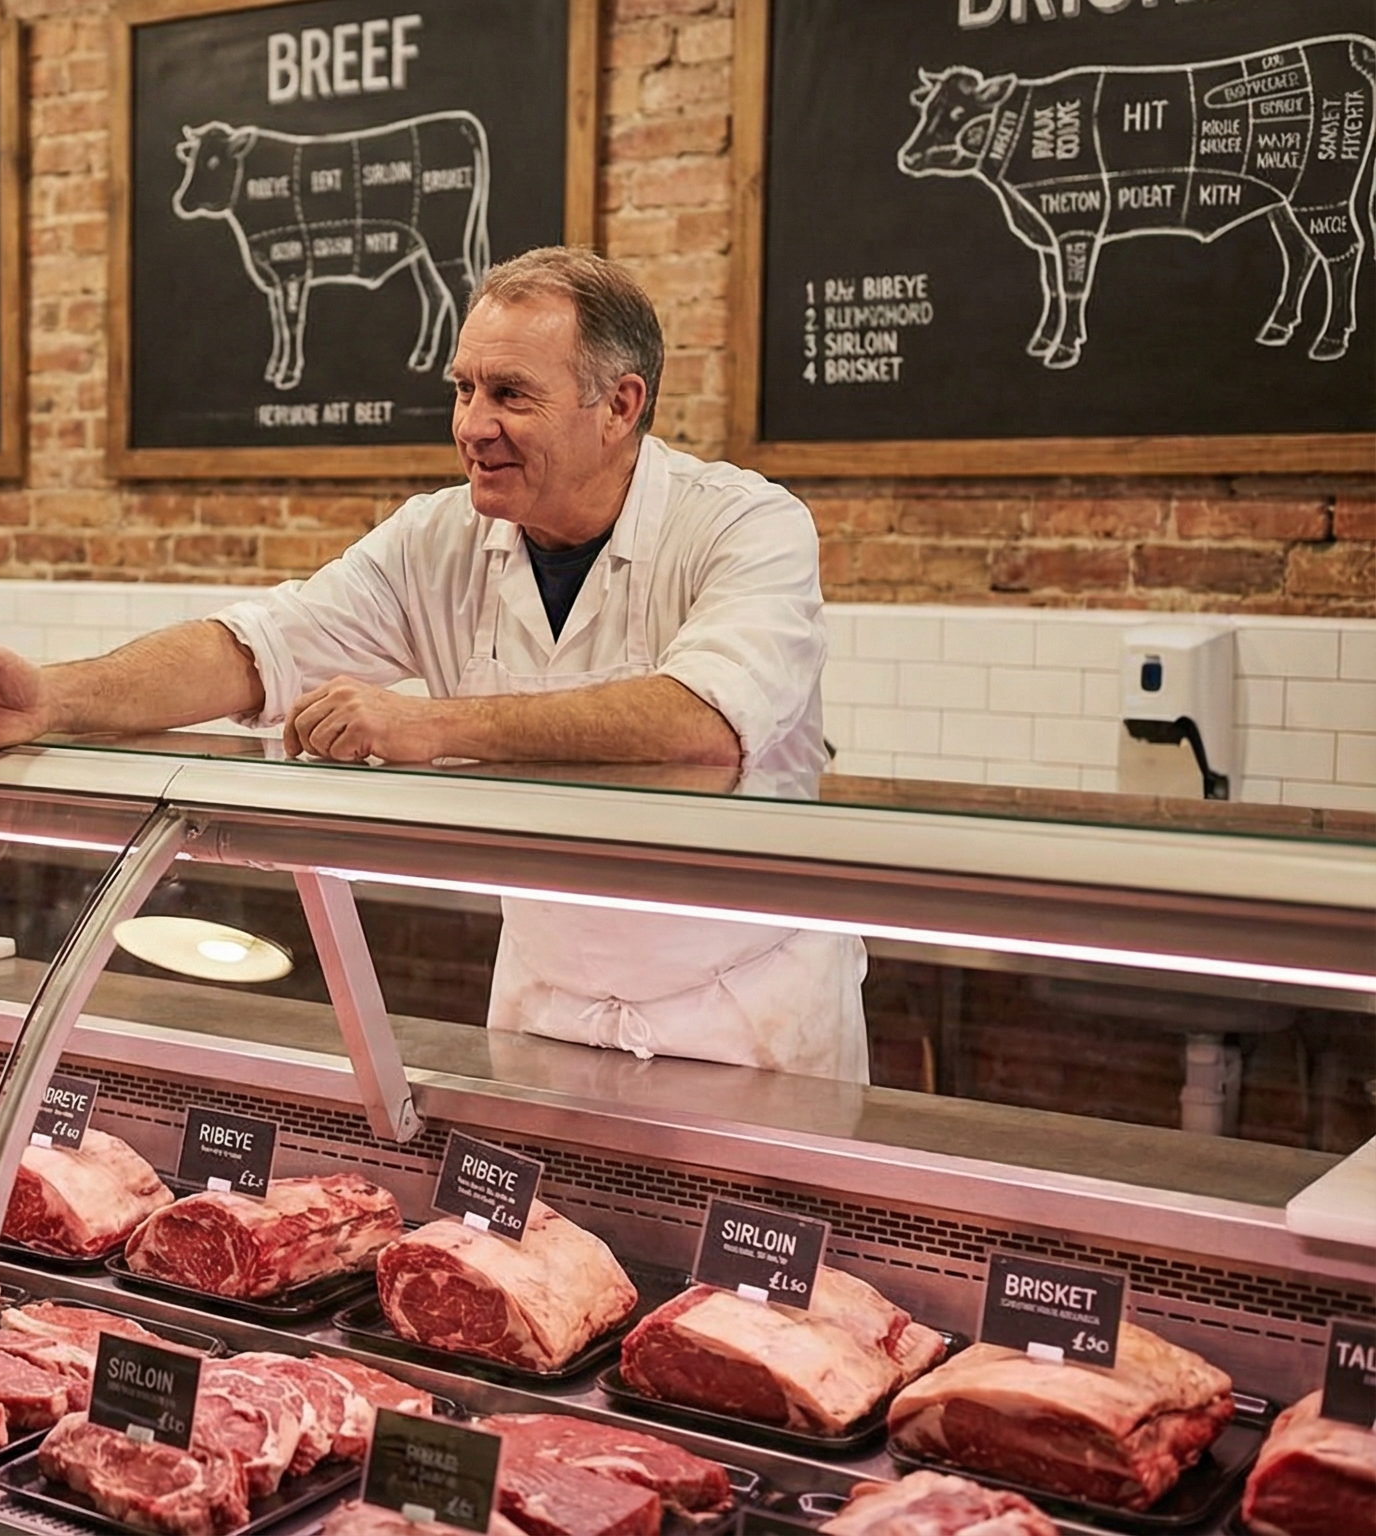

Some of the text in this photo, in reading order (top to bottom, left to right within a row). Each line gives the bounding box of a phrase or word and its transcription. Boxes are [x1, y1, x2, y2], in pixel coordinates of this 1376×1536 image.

[267, 14, 423, 104] BREEF
[1124, 99, 1169, 132] HIT
[1199, 184, 1242, 206] KITH
[806, 280, 815, 305] 1
[862, 273, 929, 301] BIBEYE
[804, 307, 819, 332] 2
[804, 329, 898, 358] 3 SIRLOIN
[802, 356, 904, 385] 4 BRISKET
[199, 1123, 254, 1151] RIBEYE
[461, 1154, 518, 1192] RIBEYE
[721, 1220, 797, 1256] SIRLOIN
[1005, 1273, 1098, 1311] BRISKET
[107, 1357, 174, 1395] SIRLOIN
